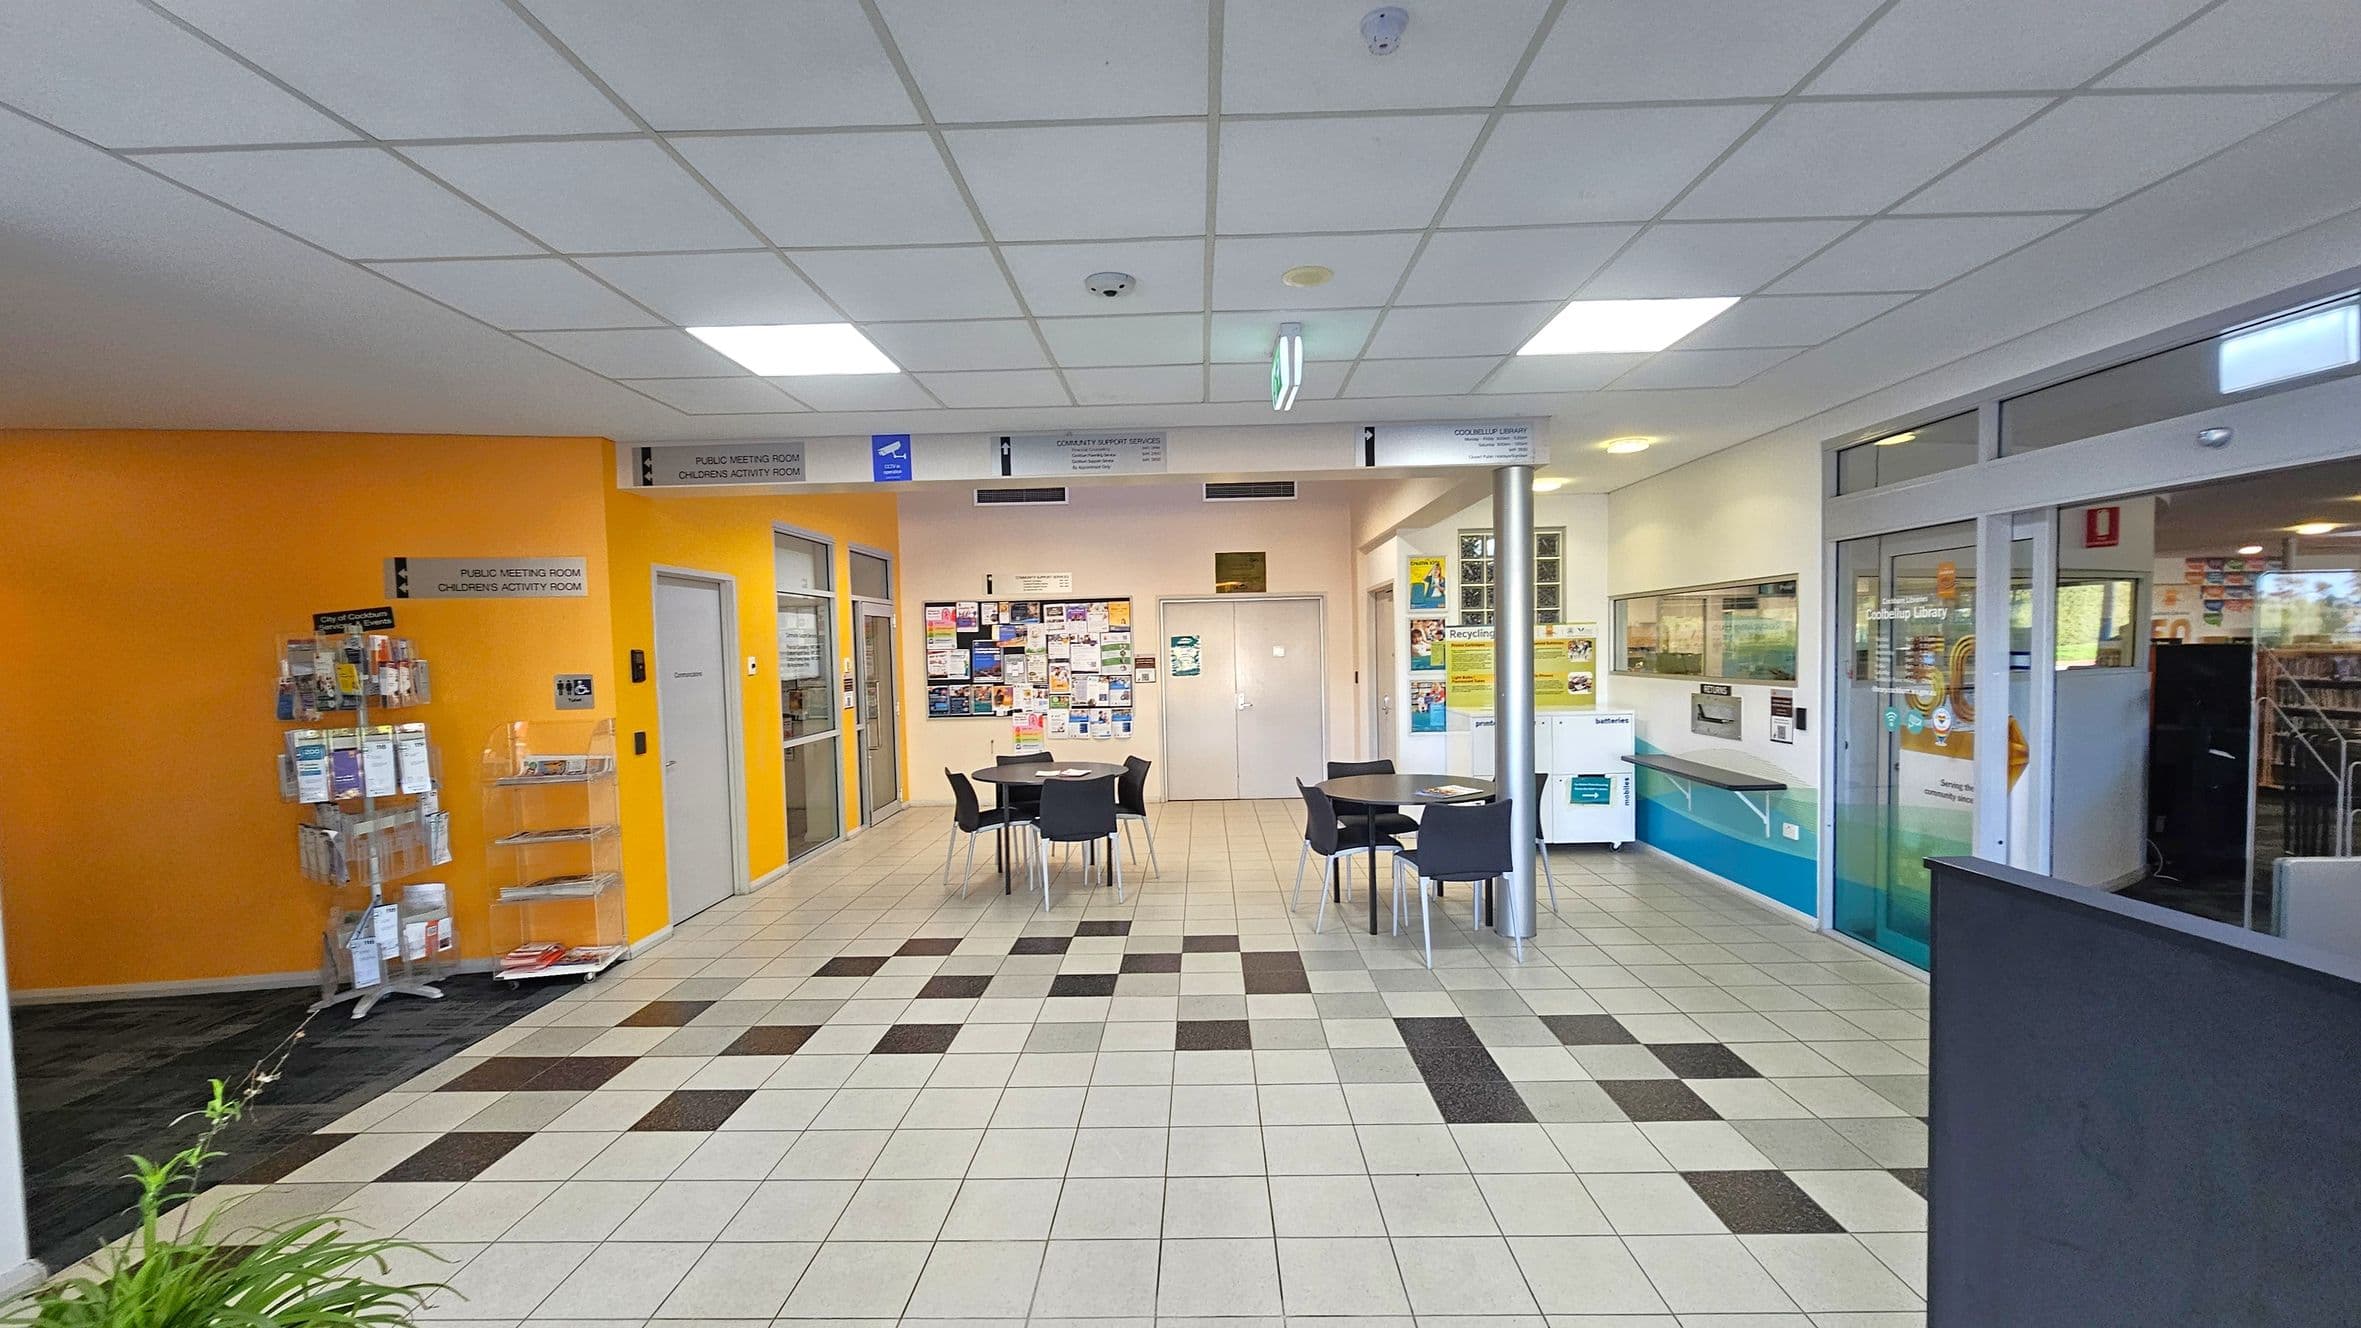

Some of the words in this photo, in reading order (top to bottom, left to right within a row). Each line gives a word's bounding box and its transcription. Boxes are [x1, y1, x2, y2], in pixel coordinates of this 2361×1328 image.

[1454, 428, 1497, 436] COOLBELLUP
[1097, 438, 1128, 446] SUPPORT
[1129, 437, 1161, 445] SERVICES
[695, 456, 728, 465] PUBLIC
[730, 455, 769, 464] MEETING
[772, 454, 800, 463] ROOM
[730, 468, 770, 478] ACTIVITY
[773, 467, 801, 476] ROOM
[460, 569, 497, 578] PUBLIC
[500, 568, 546, 578] MEETING
[549, 568, 581, 577] ROOM
[501, 583, 547, 591] ACTIVITY
[550, 582, 582, 591] ROOM
[347, 611, 388, 620] Cockburn
[1866, 608, 1910, 621] Coolbellup
[1913, 606, 1948, 620] Library
[363, 618, 392, 627] Events
[1449, 629, 1495, 640] Recycling
[1703, 686, 1728, 695] RETURNS
[1595, 717, 1630, 725] batteries
[1941, 779, 1963, 791] Serving
[1964, 784, 1974, 792] the
[1622, 777, 1630, 806] mobiles
[1924, 789, 1956, 802] community
[1957, 795, 1974, 804] since
